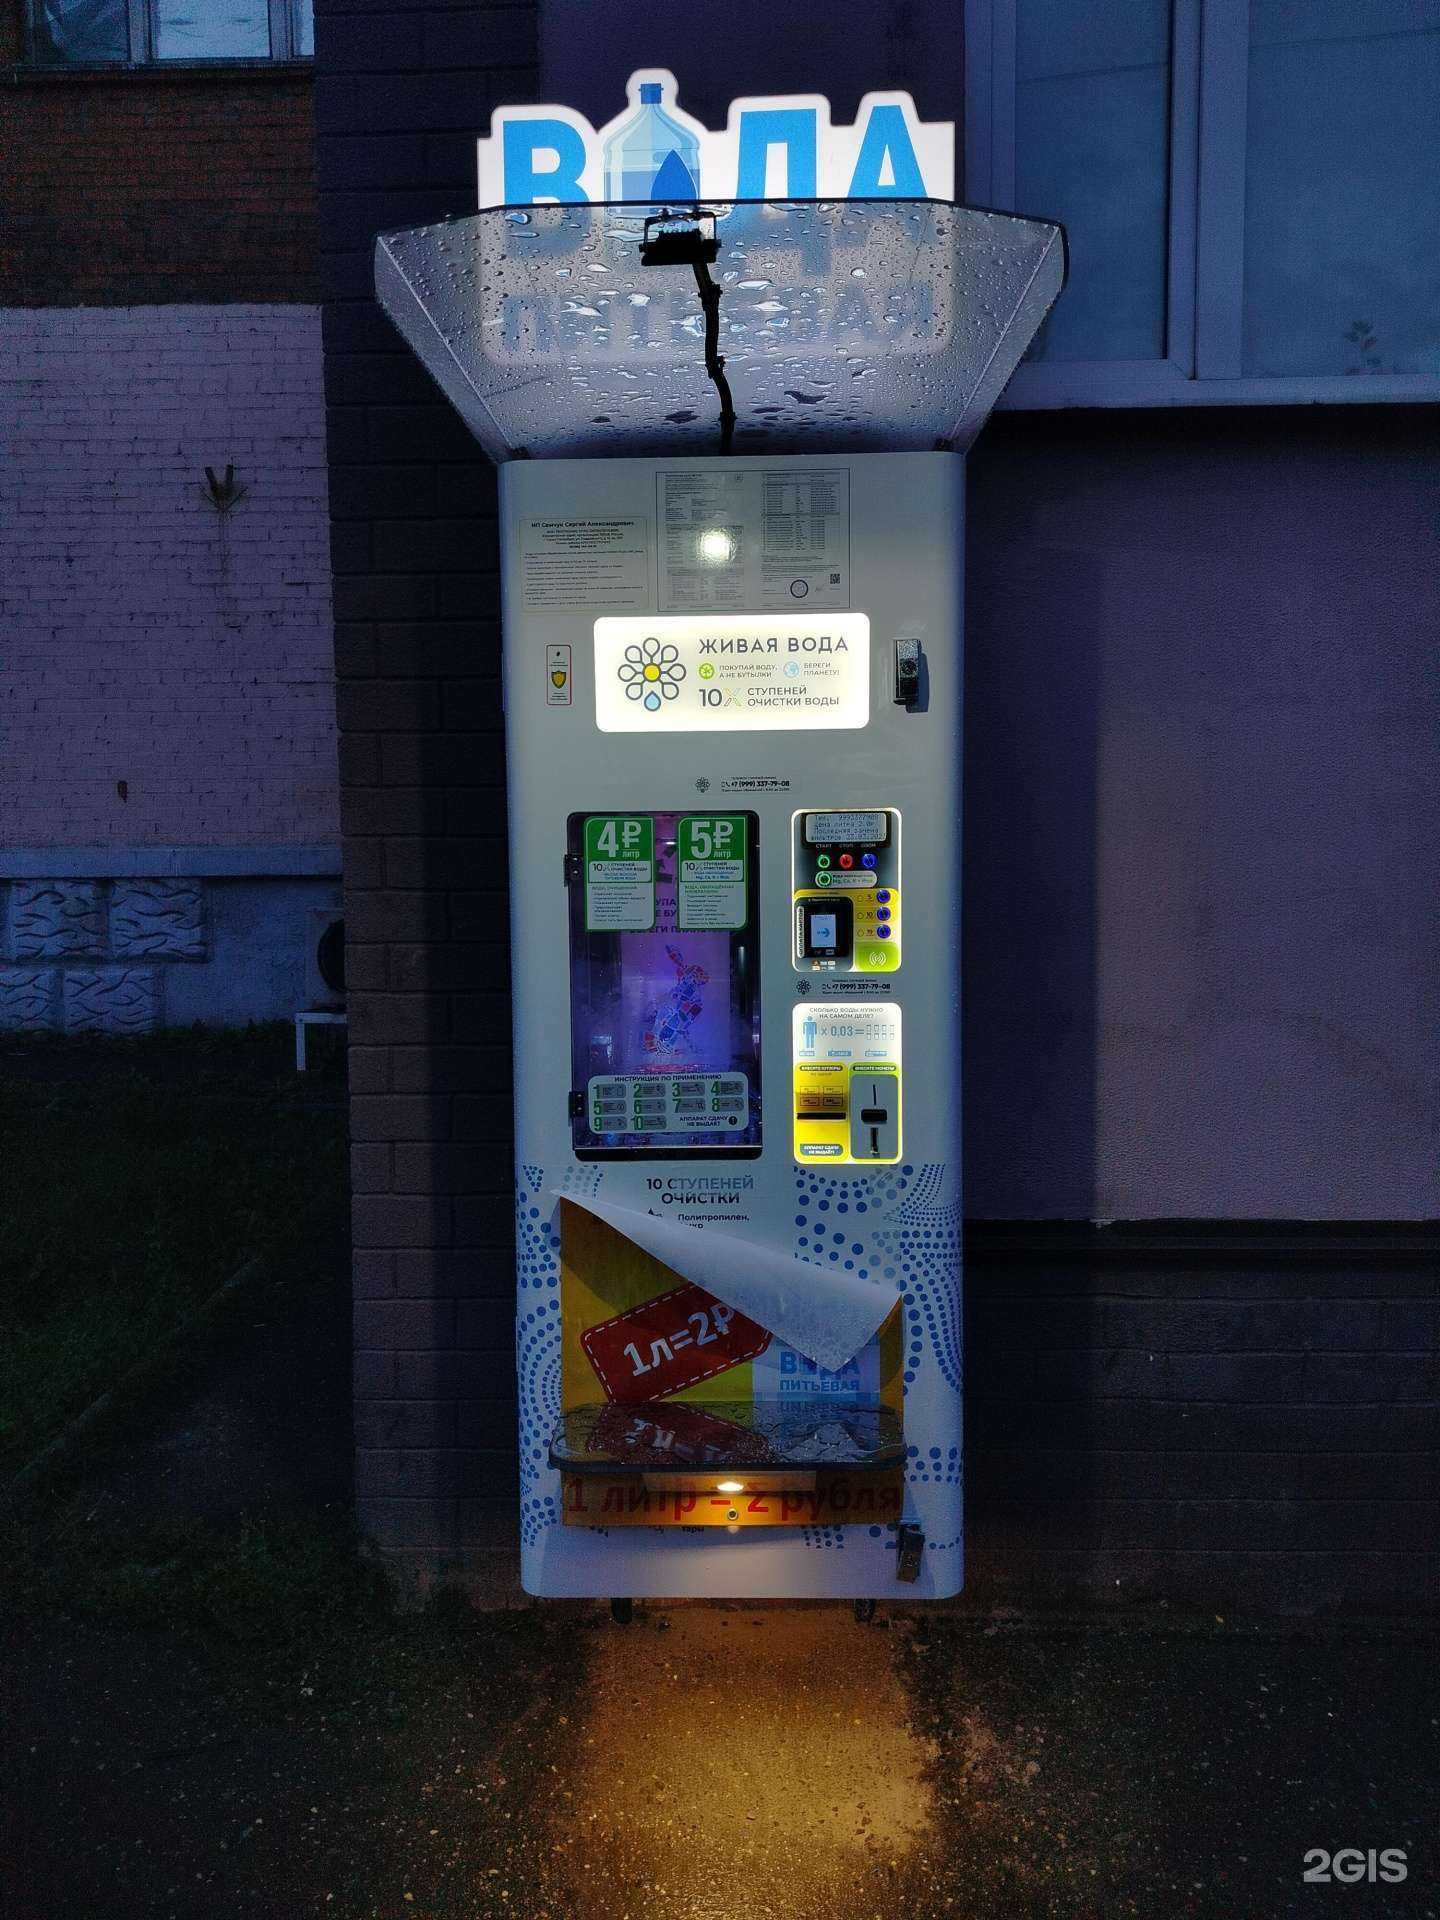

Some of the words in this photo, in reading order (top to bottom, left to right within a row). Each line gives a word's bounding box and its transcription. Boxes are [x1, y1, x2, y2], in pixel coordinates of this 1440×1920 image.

[699, 638, 778, 654] ЖИВАЯ
[788, 637, 848, 654] ВОДА
[747, 684, 807, 696] СТУПЕНЕЙ
[747, 698, 801, 707] ОЧИСТКИ
[804, 697, 839, 706] ВОДЫ
[622, 850, 640, 859] литр
[714, 849, 731, 859] литр
[593, 1084, 601, 1099] 1
[633, 1083, 641, 1098] 2
[672, 1082, 681, 1097] 3
[710, 1080, 721, 1096] 4
[593, 1101, 602, 1116] 5
[633, 1099, 641, 1115] 6
[672, 1098, 682, 1113] 7
[711, 1097, 720, 1112] 8
[593, 1117, 602, 1131] 9
[631, 1115, 644, 1131] 10
[646, 1178, 663, 1190] 10
[667, 1174, 754, 1190] СТУПЕНЕЙ
[661, 1192, 740, 1204] ОЧИСТКИ
[678, 1213, 750, 1222] Полипропилен,
[780, 1379, 860, 1392] ПИТЬЕВАЯ
[567, 1478, 588, 1512] 1
[602, 1480, 697, 1521] литр
[781, 1476, 899, 1521] рубля
